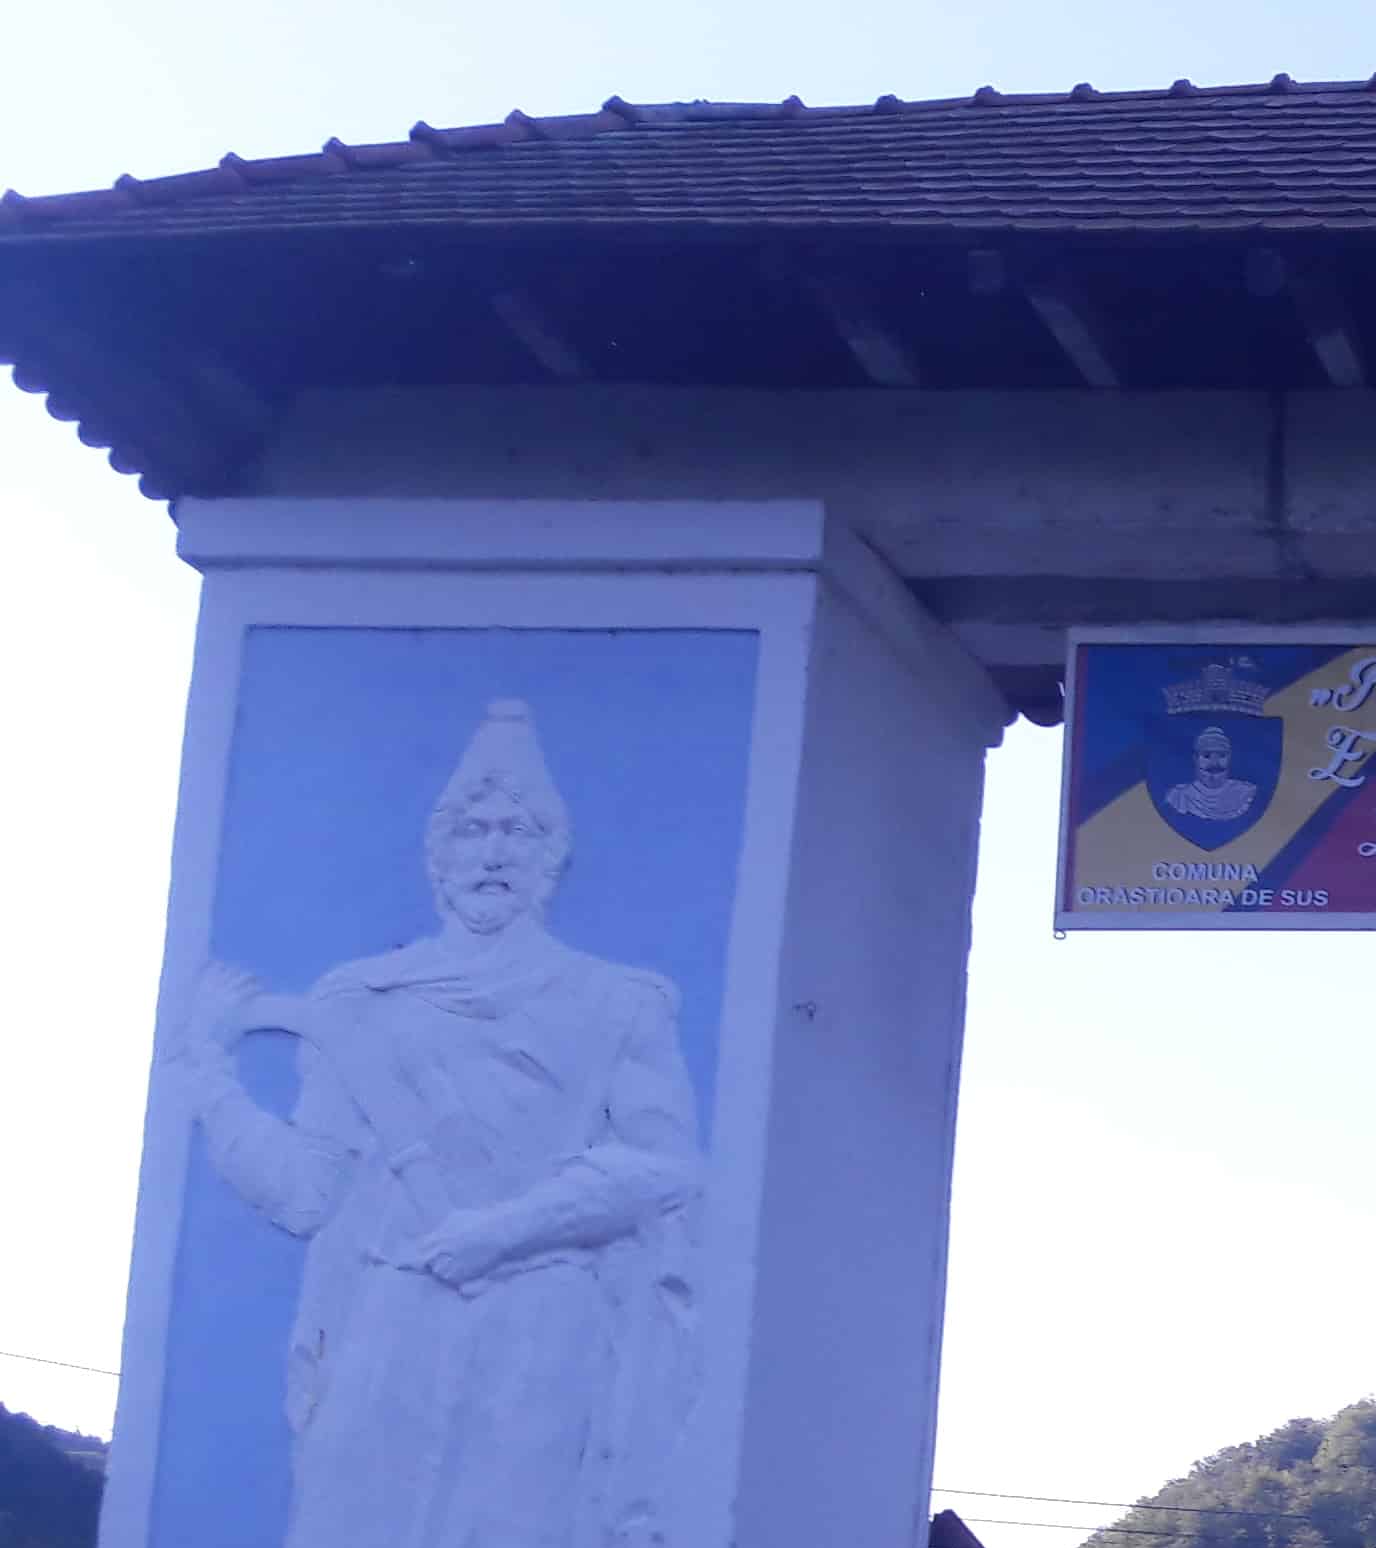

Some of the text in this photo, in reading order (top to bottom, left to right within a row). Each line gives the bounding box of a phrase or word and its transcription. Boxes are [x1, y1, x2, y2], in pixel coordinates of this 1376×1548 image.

[1152, 862, 1258, 882] COMUNA
[1241, 889, 1273, 906] DE
[1280, 889, 1329, 907] SUS
